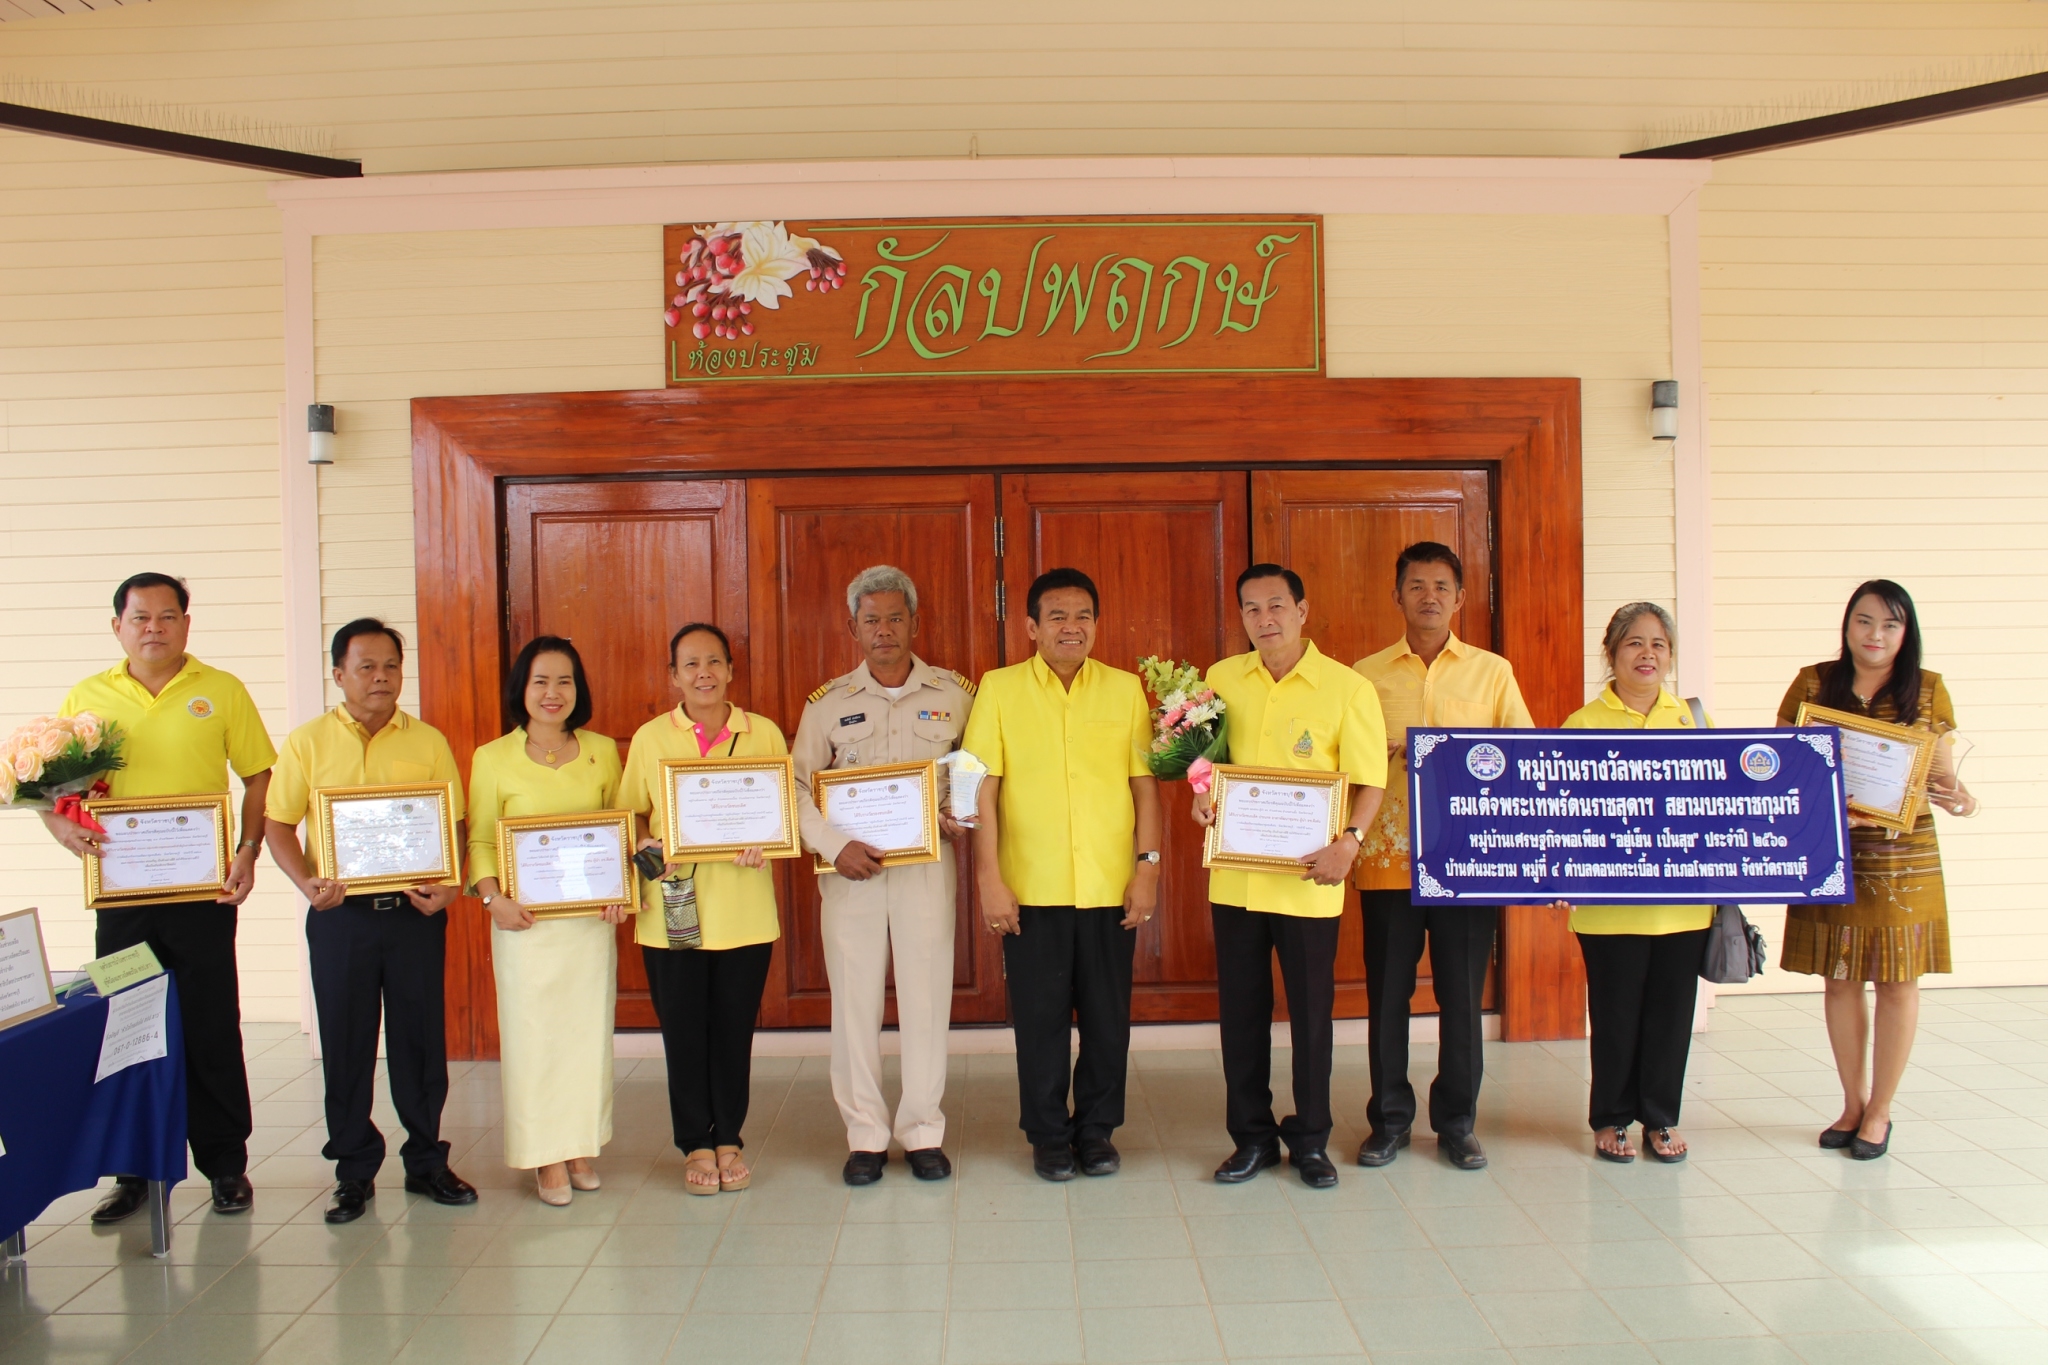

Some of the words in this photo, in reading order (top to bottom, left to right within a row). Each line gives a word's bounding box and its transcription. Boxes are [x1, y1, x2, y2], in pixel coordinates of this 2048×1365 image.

[854, 231, 1301, 361] กัลปพฤกษ์
[688, 341, 820, 376] ห้องประชุม
[1517, 750, 1727, 791] หมู่บ้านรางวัลพระราชทาน
[1450, 787, 1654, 825] สมเด็จพระเทพรัตนราชสุดาฯ
[1665, 788, 1800, 823] สยามบรมราชกุมารี
[1469, 828, 1606, 854] หมู่บ้านเศรษฐกิจพอเพียง
[1704, 828, 1749, 848] ประจำปี
[1752, 832, 1788, 848] ๒๕๖๑
[1445, 857, 1518, 877] บ้านต้นมะขาม
[1522, 854, 1547, 883] หมู่ที่
[1551, 861, 1560, 877] ๔
[1564, 852, 1660, 877] ตำบลดอนกระเบื้อง
[1663, 857, 1738, 877] อำเภอโพธาราม
[1741, 856, 1808, 881] จังหวัดราชบุรี
